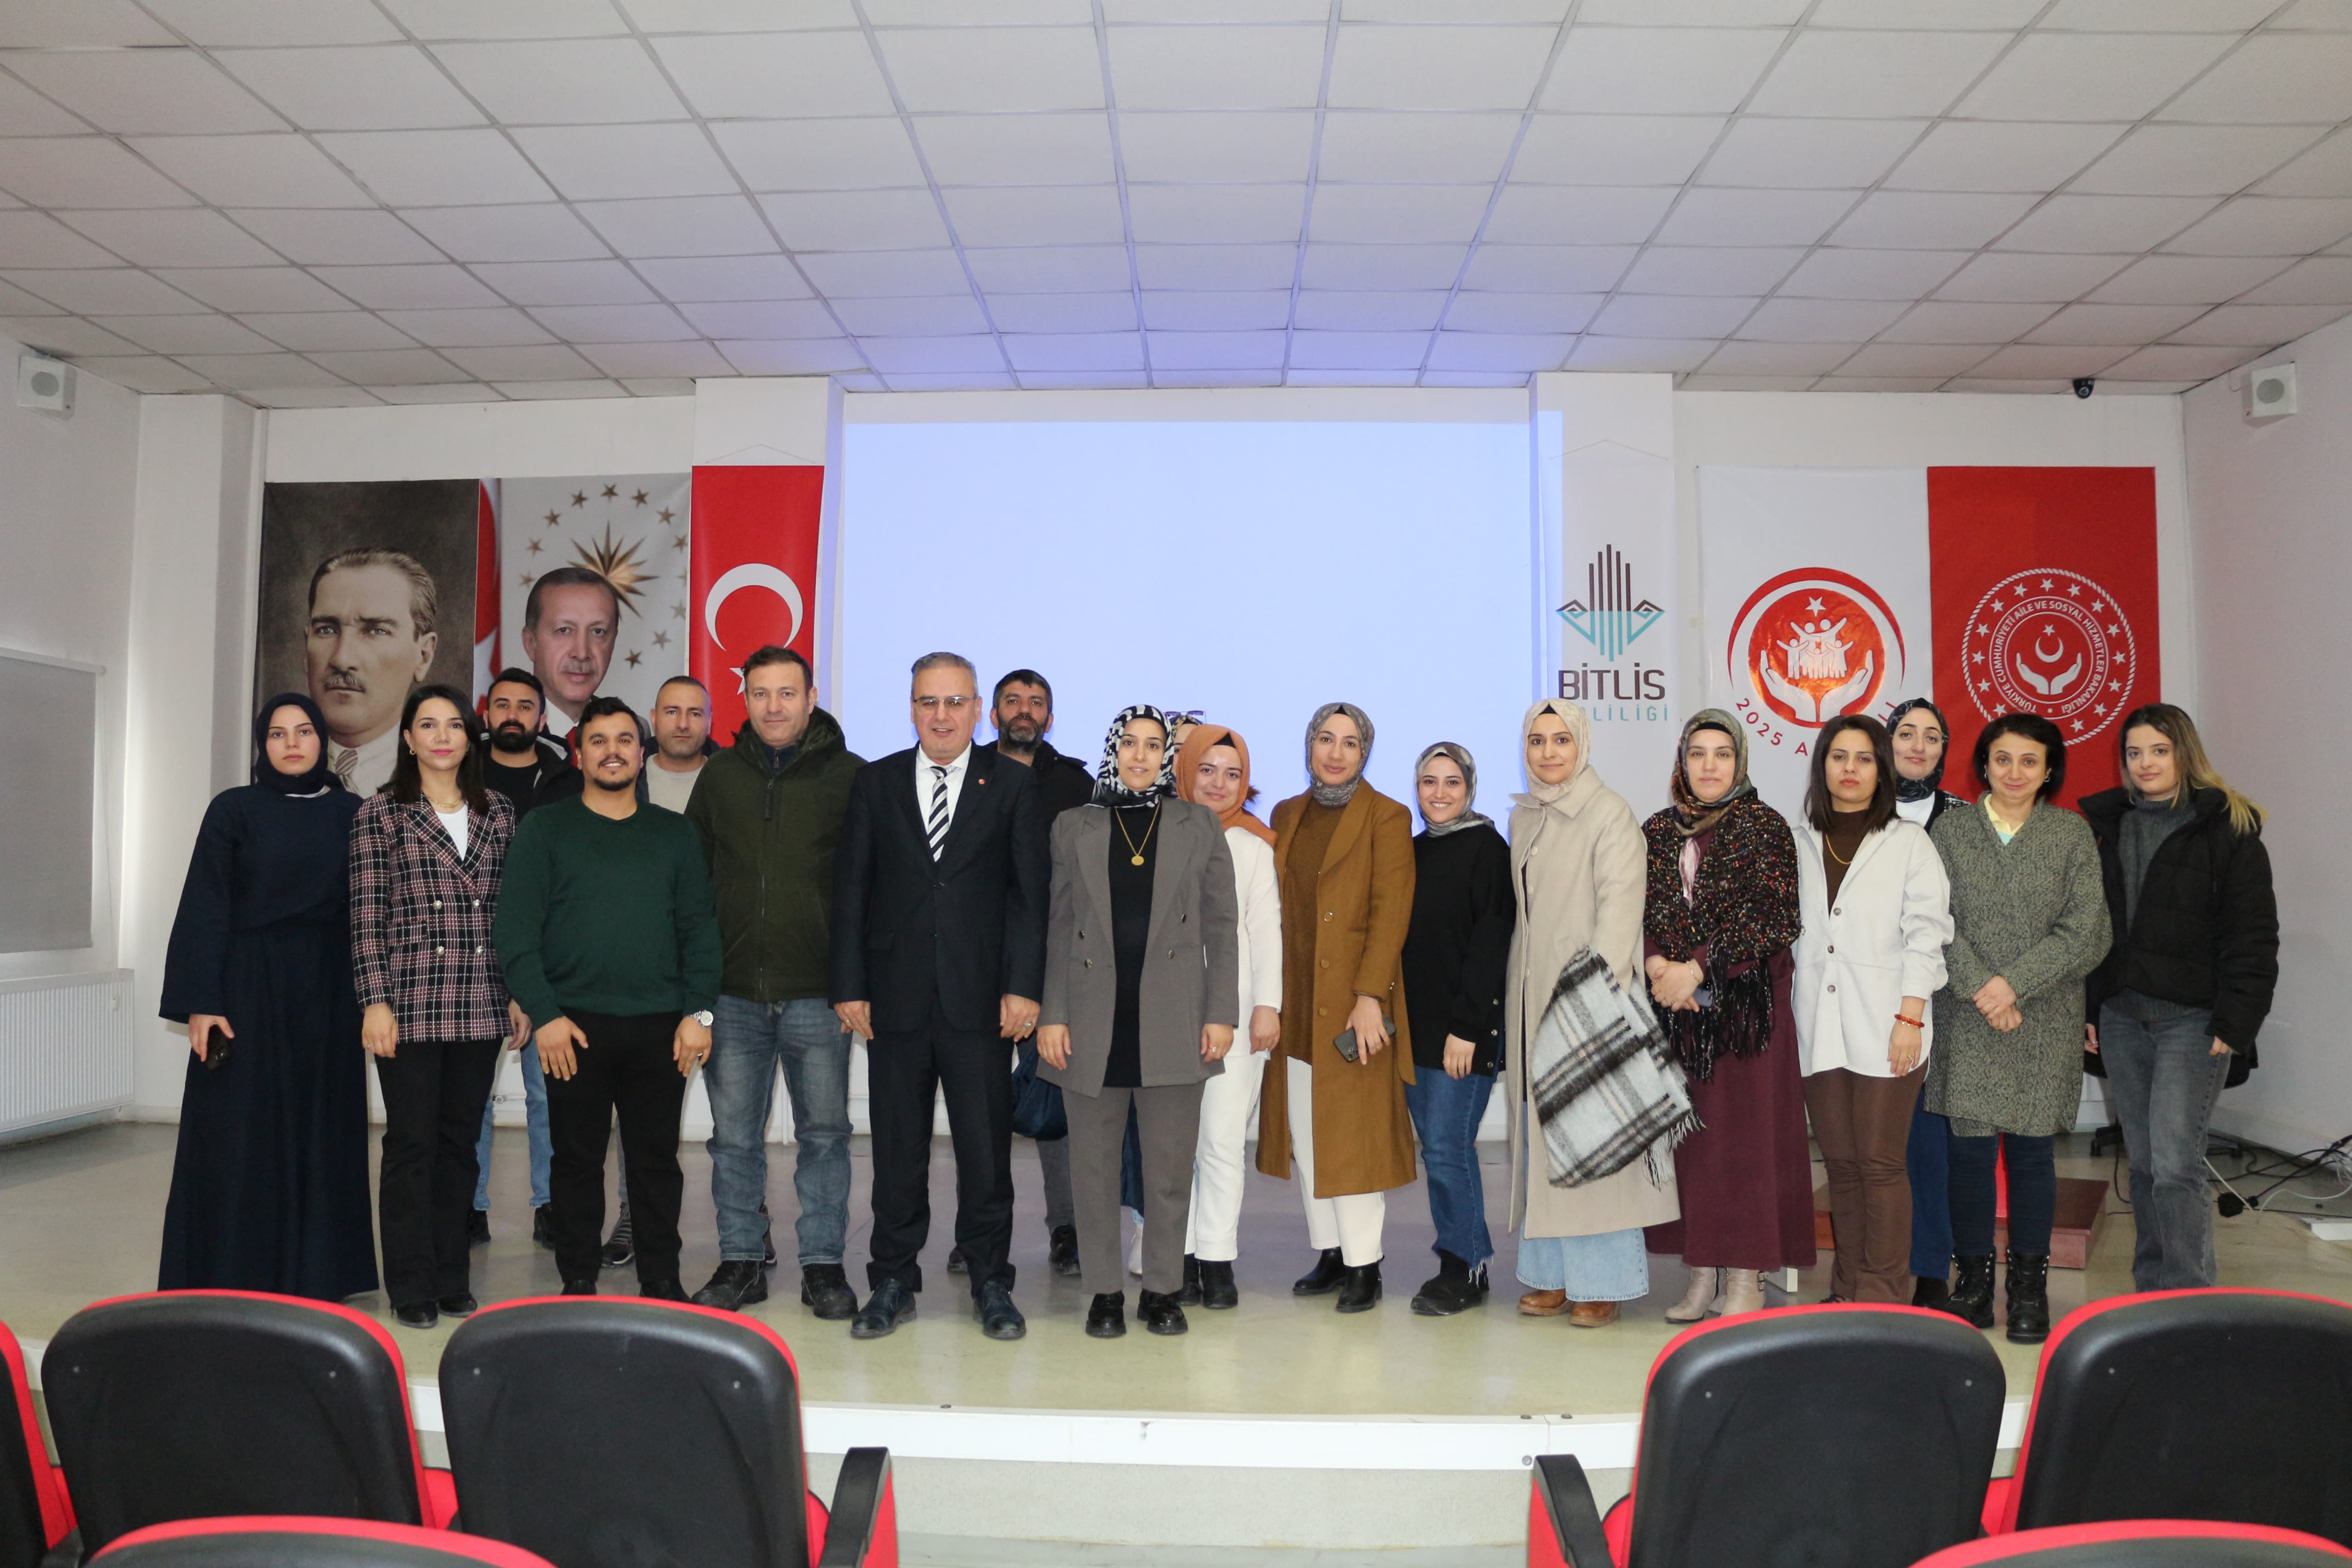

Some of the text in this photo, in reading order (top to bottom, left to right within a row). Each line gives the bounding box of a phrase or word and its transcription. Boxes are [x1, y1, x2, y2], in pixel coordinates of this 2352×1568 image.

[1993, 600, 2104, 713] TÜRKİYE CUMHURİYETİ AİLE VE SOSYAL HİZMETLER BAKANLIĞI
[1558, 662, 1665, 700] BİTLİS
[1581, 704, 1668, 721] LİLİĞİ
[1736, 698, 1783, 746] 2025
